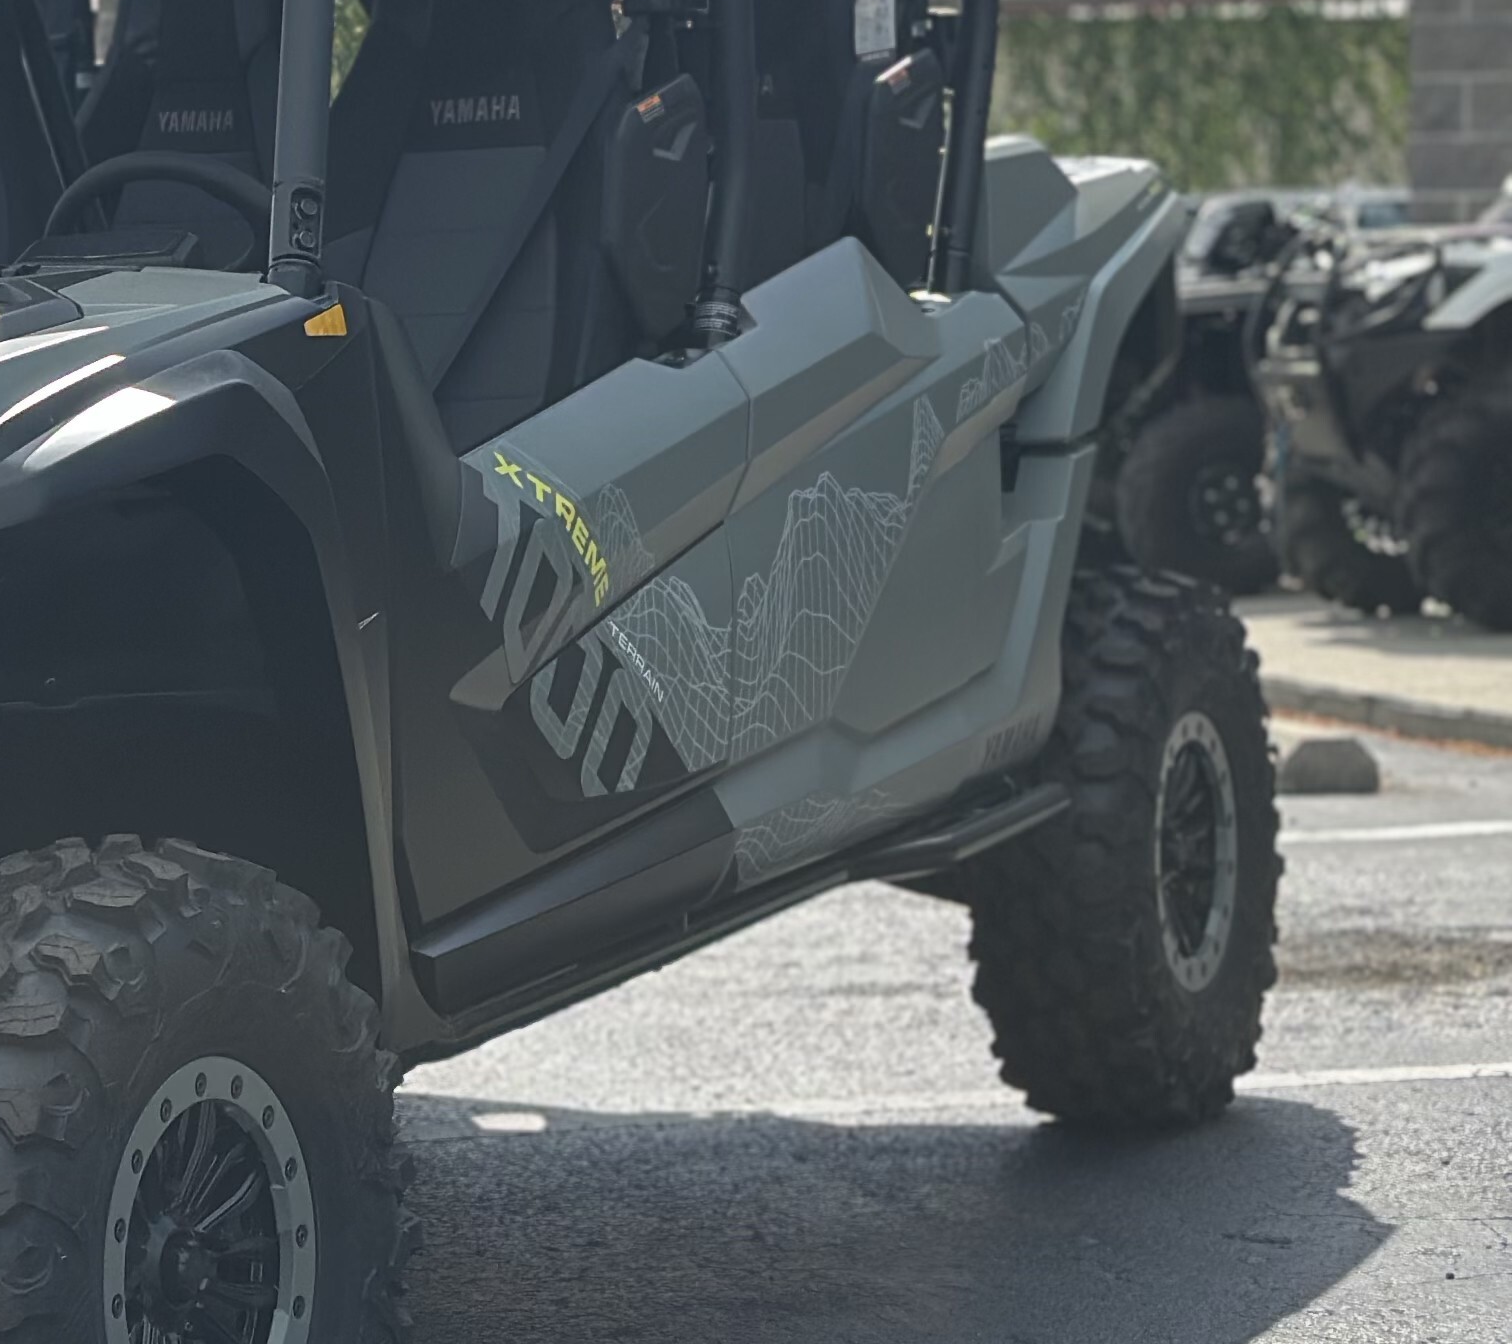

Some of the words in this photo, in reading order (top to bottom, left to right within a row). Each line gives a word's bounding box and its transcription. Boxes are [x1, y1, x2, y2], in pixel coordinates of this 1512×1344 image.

[159, 109, 234, 133] YAMAHA
[430, 94, 521, 127] YAMAHA
[493, 450, 610, 608] XTREME
